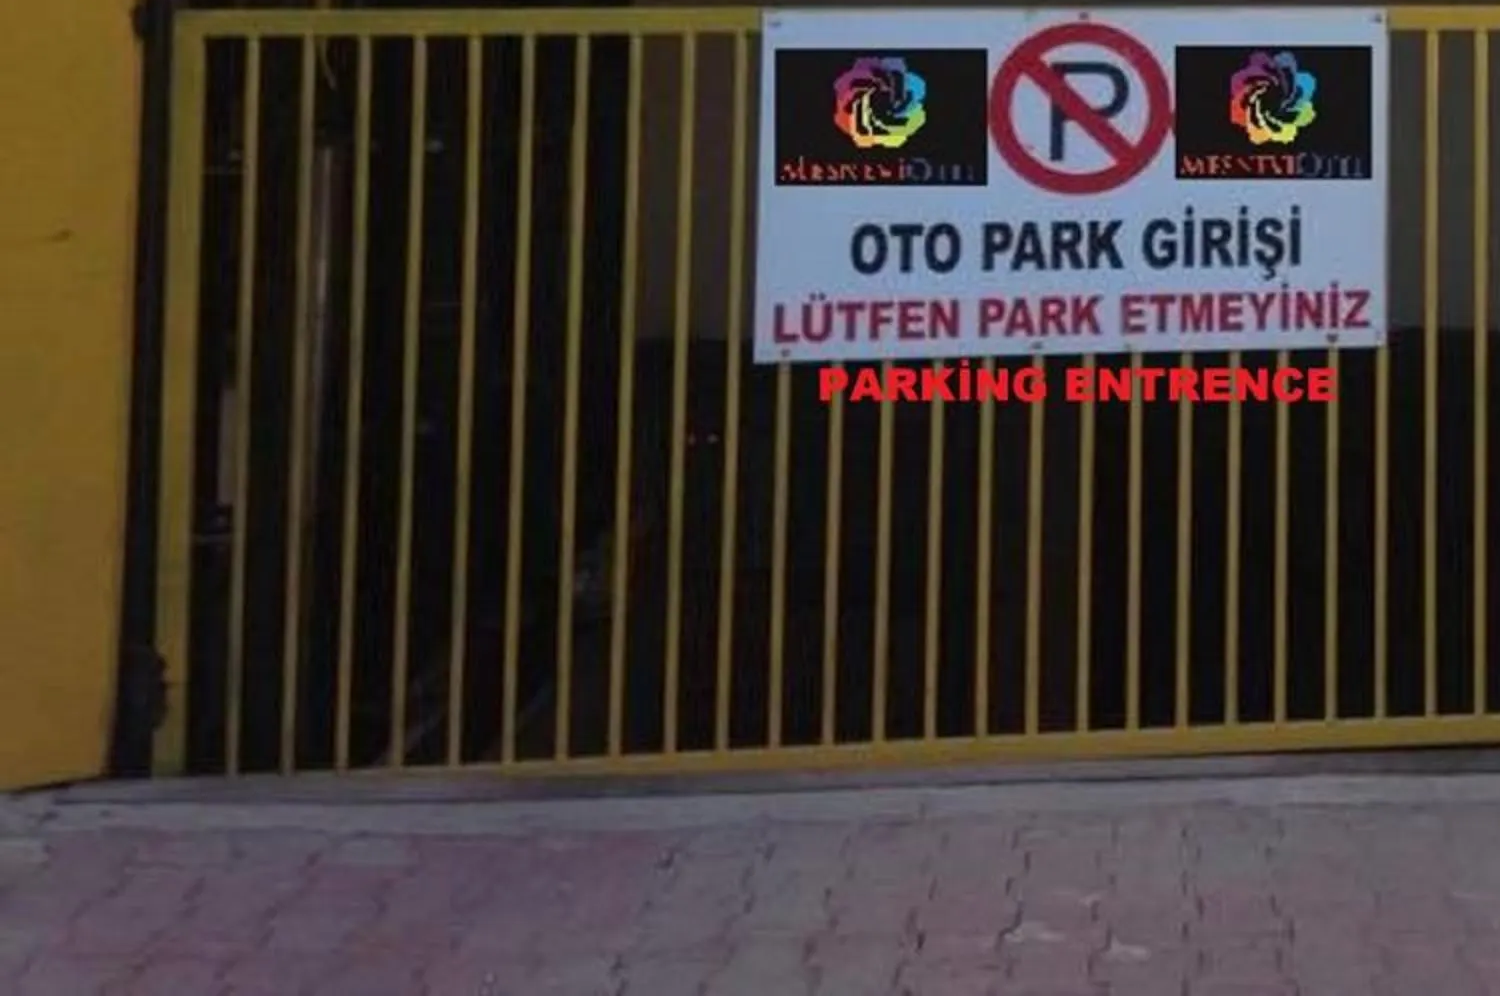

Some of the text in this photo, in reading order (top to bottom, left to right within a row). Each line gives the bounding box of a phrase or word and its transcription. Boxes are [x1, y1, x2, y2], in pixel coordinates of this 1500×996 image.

[850, 205, 1301, 280] OTO PARK GİRİŞİ
[772, 281, 1371, 344] LÜTFEN PARK ETMEYİNİZ
